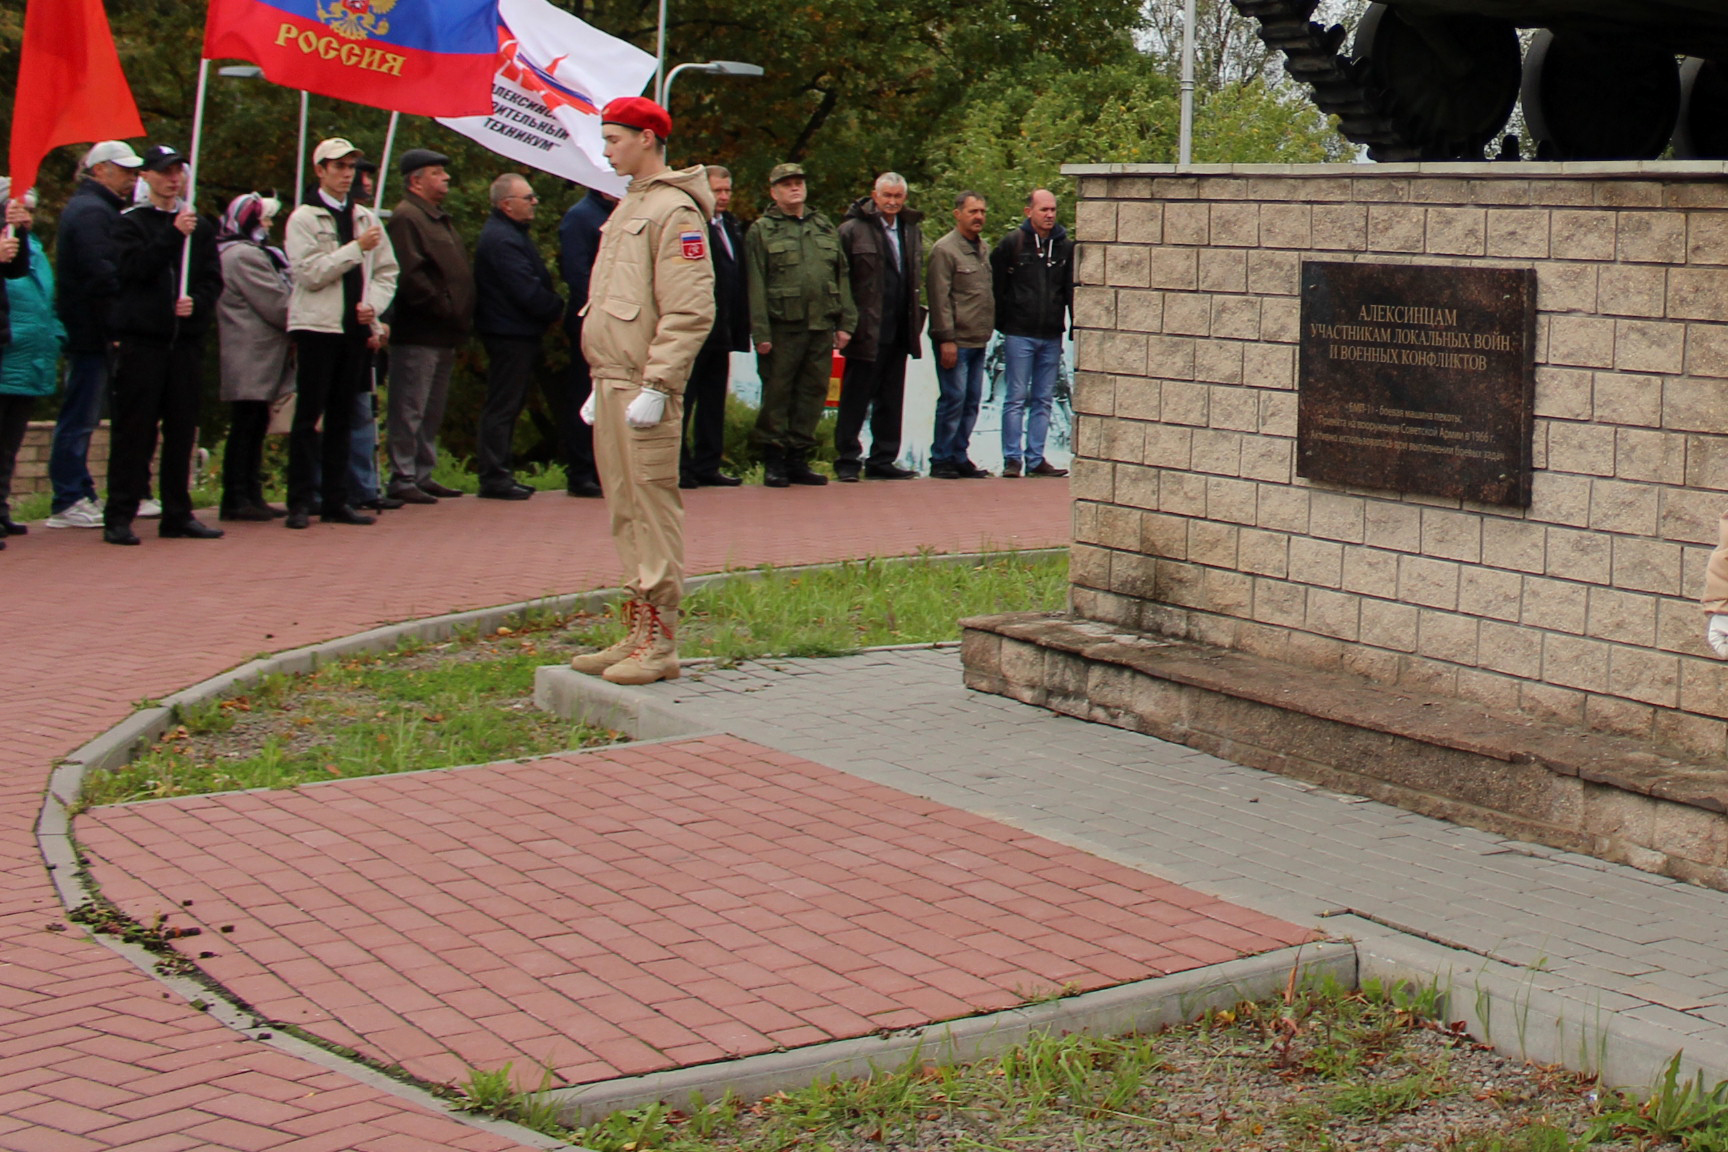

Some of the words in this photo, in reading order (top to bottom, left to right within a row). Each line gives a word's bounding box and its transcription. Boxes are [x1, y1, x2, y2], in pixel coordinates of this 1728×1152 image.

[274, 23, 407, 77] РОССИЯ
[1358, 304, 1457, 326] АЛЕКСИНЦАМ
[1311, 323, 1391, 343] УЧАСТНИКАМ
[1393, 328, 1471, 349] ЛОКАЛЬНЫХ
[1474, 331, 1511, 351] ВОЙН
[1329, 345, 1338, 359] И
[1340, 345, 1399, 364] ВОЕННЫХ
[1401, 350, 1487, 370] КОНФЛИКТОВ
